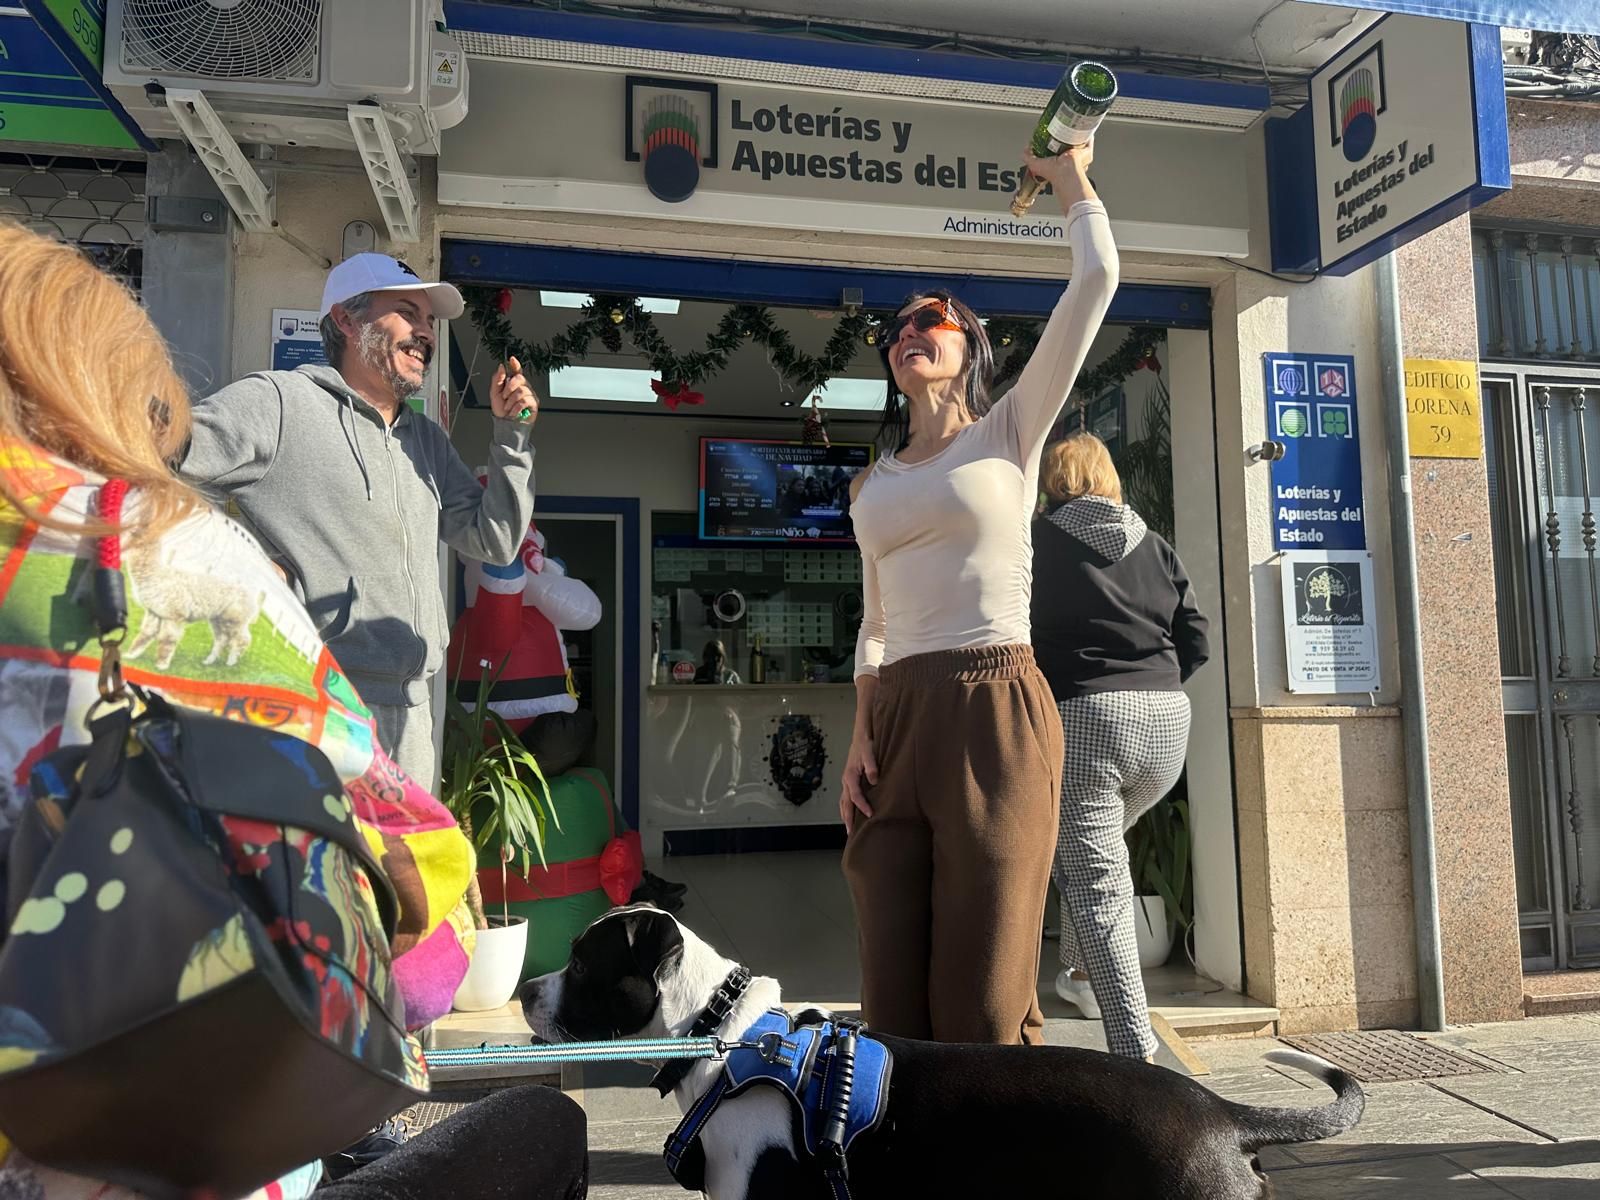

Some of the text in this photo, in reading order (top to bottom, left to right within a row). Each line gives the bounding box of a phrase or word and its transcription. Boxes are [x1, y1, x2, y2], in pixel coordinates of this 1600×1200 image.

[72, 8, 98, 55] 959
[731, 99, 912, 153] Loterías y
[731, 140, 903, 184] Apuestas
[914, 154, 966, 189] del
[1334, 140, 1408, 198] Loterías y
[1336, 144, 1434, 220] Apuestas del
[943, 216, 1063, 238] Administración
[1337, 204, 1387, 243] Estado
[1404, 371, 1471, 390] EDIFICIO
[1405, 397, 1472, 416] LORENA
[1430, 425, 1451, 443] 39
[1277, 485, 1341, 503] Loterías y
[1278, 506, 1361, 524] Apuestas del
[1279, 528, 1324, 542] Estado
